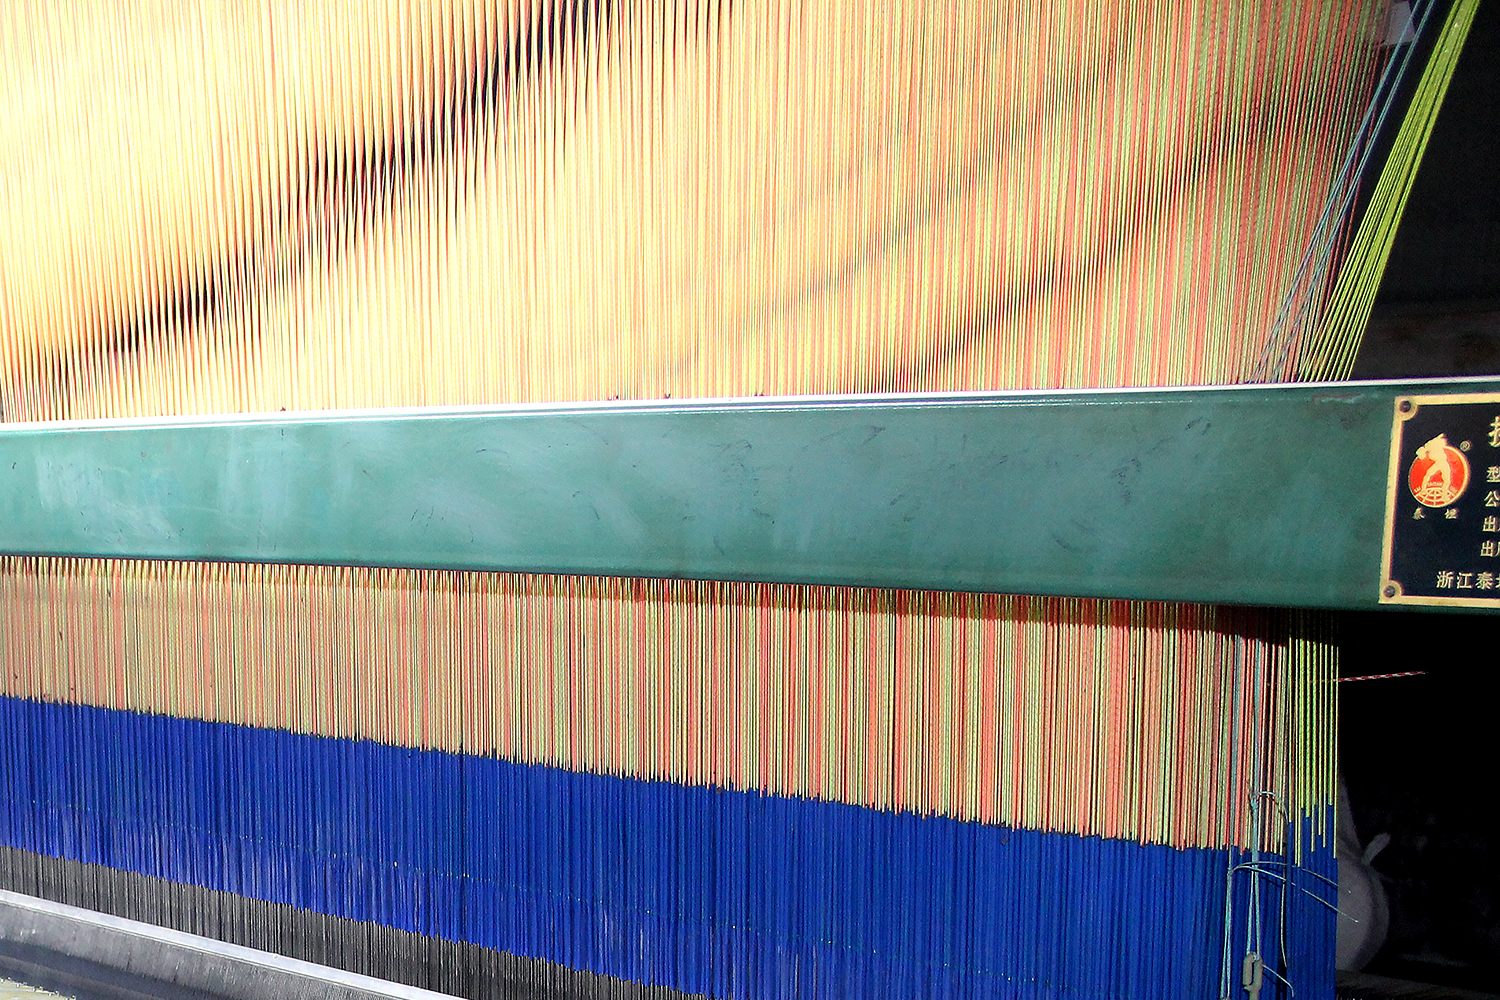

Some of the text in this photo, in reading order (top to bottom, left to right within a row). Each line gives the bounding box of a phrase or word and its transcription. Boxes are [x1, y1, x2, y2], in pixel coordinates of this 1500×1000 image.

[1484, 490, 1500, 507] 公
[1482, 515, 1500, 532] 出
[1436, 570, 1500, 590] 浙江泰
